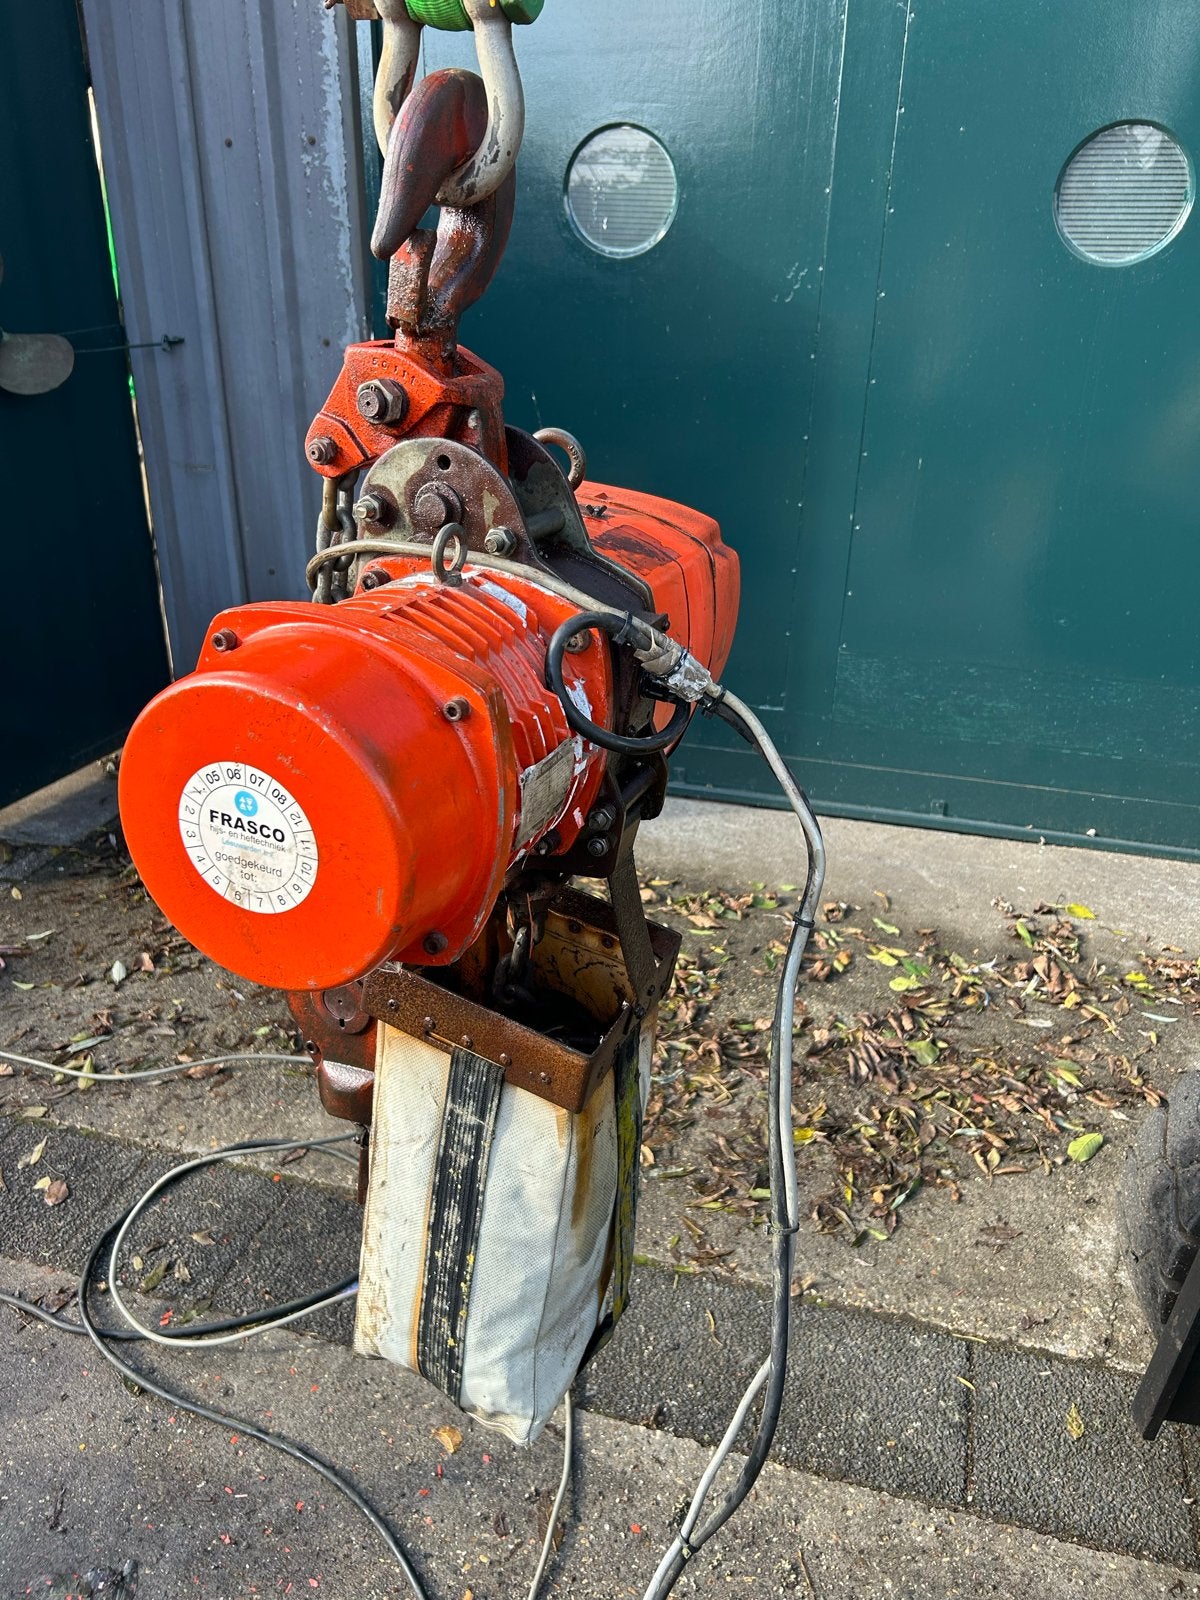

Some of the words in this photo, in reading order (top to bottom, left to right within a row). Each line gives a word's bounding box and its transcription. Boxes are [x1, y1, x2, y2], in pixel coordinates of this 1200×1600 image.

[206, 770, 220, 784] 05
[226, 768, 241, 780] 06
[249, 773, 265, 787] 07
[271, 788, 287, 805] 08
[184, 805, 195, 815] 2
[290, 811, 303, 826] 12
[209, 809, 285, 843] FRASCO
[186, 830, 197, 838] 3
[197, 855, 206, 863] 4
[215, 851, 282, 877] goedgekeurd
[301, 862, 312, 876] 10
[212, 875, 221, 885] 5
[292, 883, 303, 894] 9
[234, 890, 242, 901] 6
[277, 894, 286, 906] 8
[256, 897, 264, 908] 7
